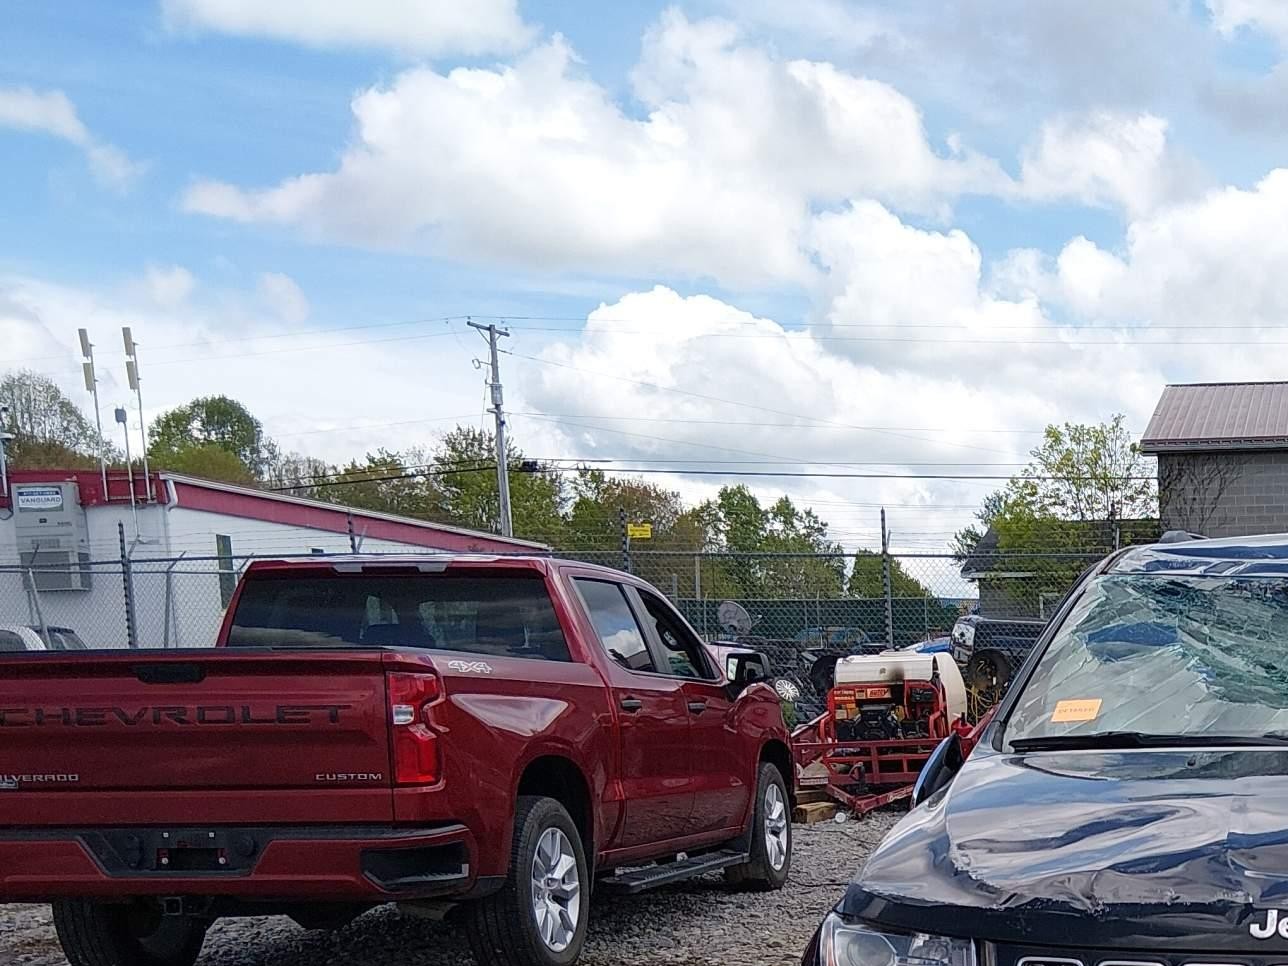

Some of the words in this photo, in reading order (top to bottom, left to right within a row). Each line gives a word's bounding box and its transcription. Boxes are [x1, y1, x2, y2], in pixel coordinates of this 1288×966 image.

[20, 496, 61, 504] VANGUARD
[0, 703, 353, 727] CHEVROLET
[0, 774, 79, 782] ILVERADO
